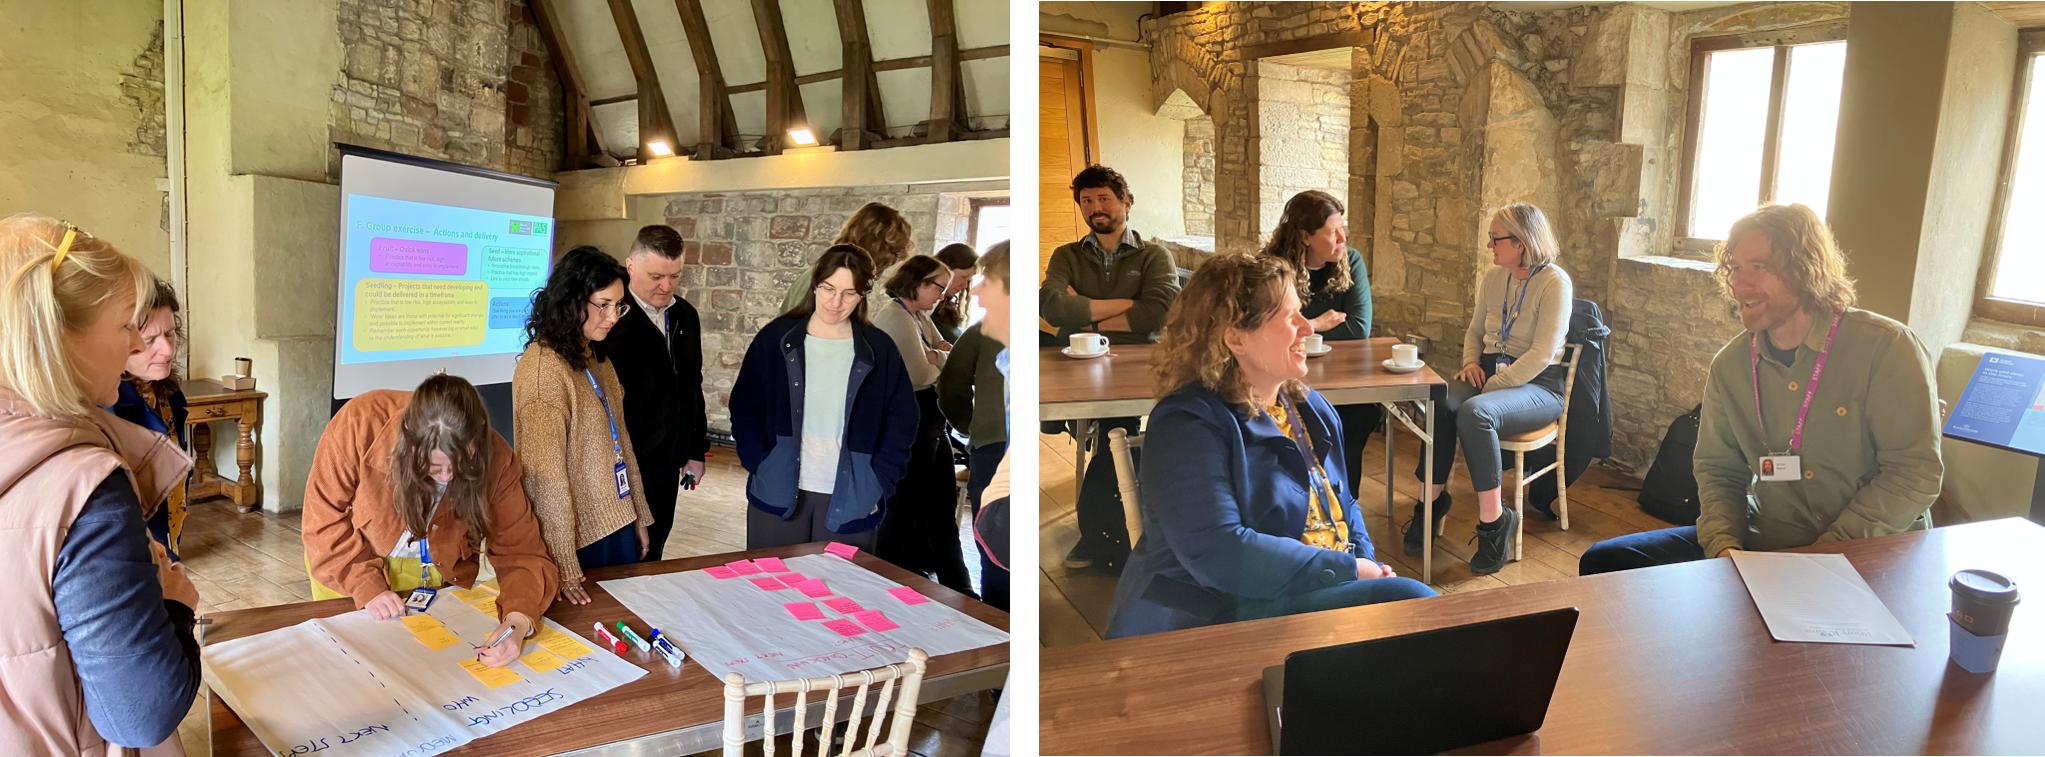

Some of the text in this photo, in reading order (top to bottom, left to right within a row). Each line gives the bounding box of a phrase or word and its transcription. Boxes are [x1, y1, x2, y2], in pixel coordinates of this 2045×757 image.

[357, 220, 364, 230] F.
[366, 221, 391, 234] Group
[393, 225, 424, 235] exercise
[433, 228, 459, 238] Actions
[460, 231, 473, 239] and
[474, 232, 498, 242] delivery
[533, 222, 547, 234] PAS
[379, 244, 394, 252] Fruit
[399, 245, 416, 253] Quick
[515, 249, 541, 257] aspirational
[365, 281, 393, 290] Seedling
[398, 282, 421, 290] Projects
[1812, 363, 1822, 381] STAFF
[1803, 390, 1813, 408] STAFF
[555, 656, 600, 675] WHAT
[443, 695, 480, 711] WHO
[337, 724, 390, 744] NEXT
